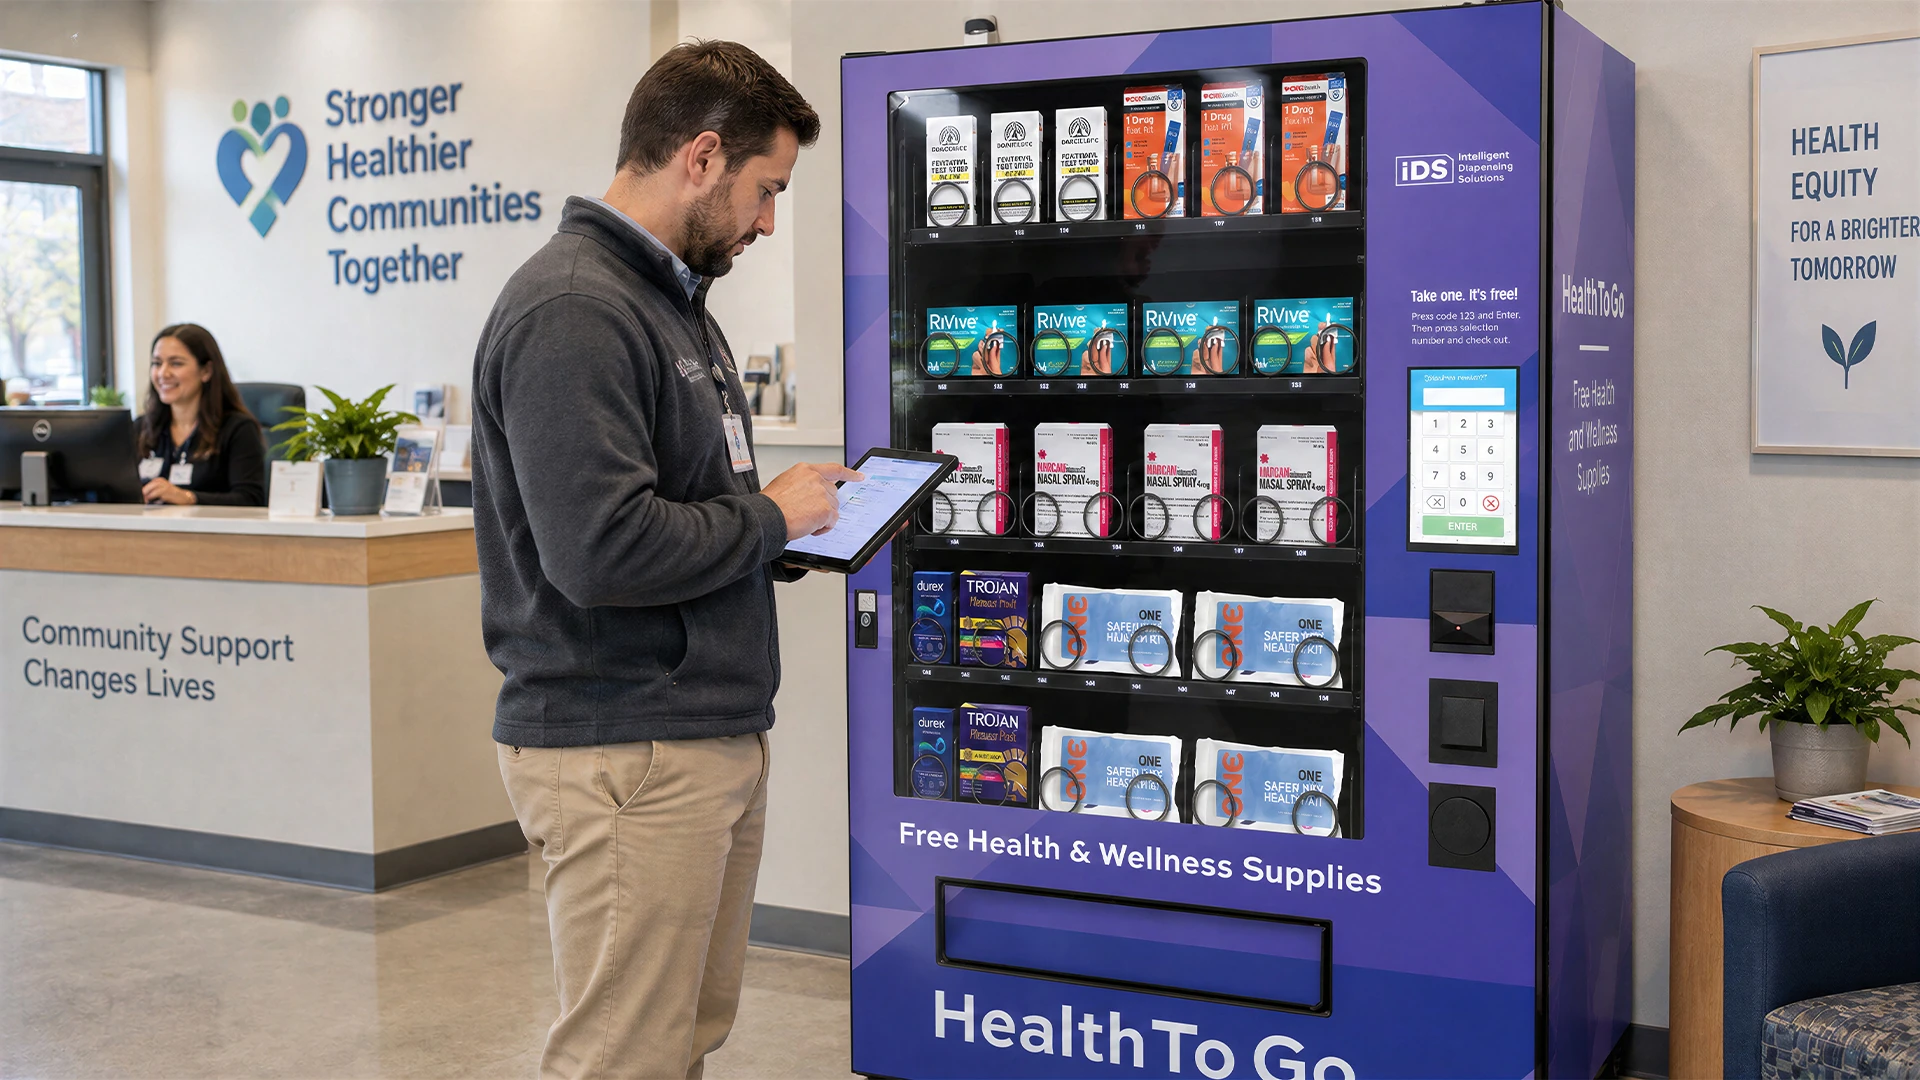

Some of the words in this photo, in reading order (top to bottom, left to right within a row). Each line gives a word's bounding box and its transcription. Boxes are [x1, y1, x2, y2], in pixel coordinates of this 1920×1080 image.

[325, 81, 463, 127] Stronger
[1792, 121, 1879, 156] HEALTH
[326, 134, 472, 181] Healthier
[1458, 151, 1510, 162] Intelligent
[1458, 174, 1505, 184] Solutions
[1791, 167, 1879, 202] EQUITY
[326, 183, 541, 233] Communities
[1791, 220, 1821, 243] FOR
[1825, 219, 1836, 241] A
[1841, 215, 1920, 241] BRIGHTER
[327, 244, 463, 294] Together
[1790, 254, 1897, 281] TOMORROW
[1411, 290, 1437, 302] Take
[1440, 291, 1465, 301] one.
[1469, 288, 1487, 301] It's
[1490, 287, 1518, 301] free!
[1435, 311, 1458, 321] code
[1460, 311, 1475, 320] 123
[1477, 311, 1494, 320] and
[1496, 310, 1521, 320] Enter.
[1411, 324, 1433, 332] Then
[1447, 336, 1464, 345] and
[1465, 336, 1491, 344] check
[1573, 379, 1590, 409] Free
[1591, 378, 1615, 407] Health
[1460, 419, 1467, 429] 2
[1487, 419, 1494, 428] 3
[1568, 421, 1584, 452] and
[1432, 445, 1439, 454] 4
[1460, 445, 1467, 455] 5
[1487, 446, 1494, 455] 6
[960, 473, 982, 484] SPRAY
[1037, 473, 1061, 485] NASAL
[1063, 474, 1085, 485] SPRAY
[1432, 471, 1439, 480] 7
[1459, 471, 1466, 481] 8
[1487, 471, 1494, 481] 9
[1577, 459, 1610, 495] Supplies
[1286, 479, 1311, 491] SPRAY
[1459, 497, 1466, 507] 0
[1448, 522, 1478, 531] ENTER
[917, 580, 944, 592] durex
[966, 579, 1019, 595] TROJAN
[1138, 609, 1162, 622] ONE
[1067, 595, 1088, 657] ONE
[1298, 618, 1322, 631] ONE
[22, 615, 171, 661] Community
[181, 626, 294, 667] Support
[1221, 603, 1243, 668] ONE
[1264, 630, 1299, 643] SAFER
[23, 659, 137, 699] Changes
[145, 667, 216, 701] Lives
[967, 712, 1019, 729] TROJAN
[1138, 754, 1161, 767] ONE
[1066, 738, 1087, 801] ONE
[1298, 769, 1322, 782] ONE
[1221, 751, 1244, 817] ONE
[899, 822, 959, 851] Free
[968, 828, 1060, 861] Health
[1069, 839, 1091, 864] &
[1099, 842, 1233, 880] Wellness
[1242, 855, 1383, 895] Supplies
